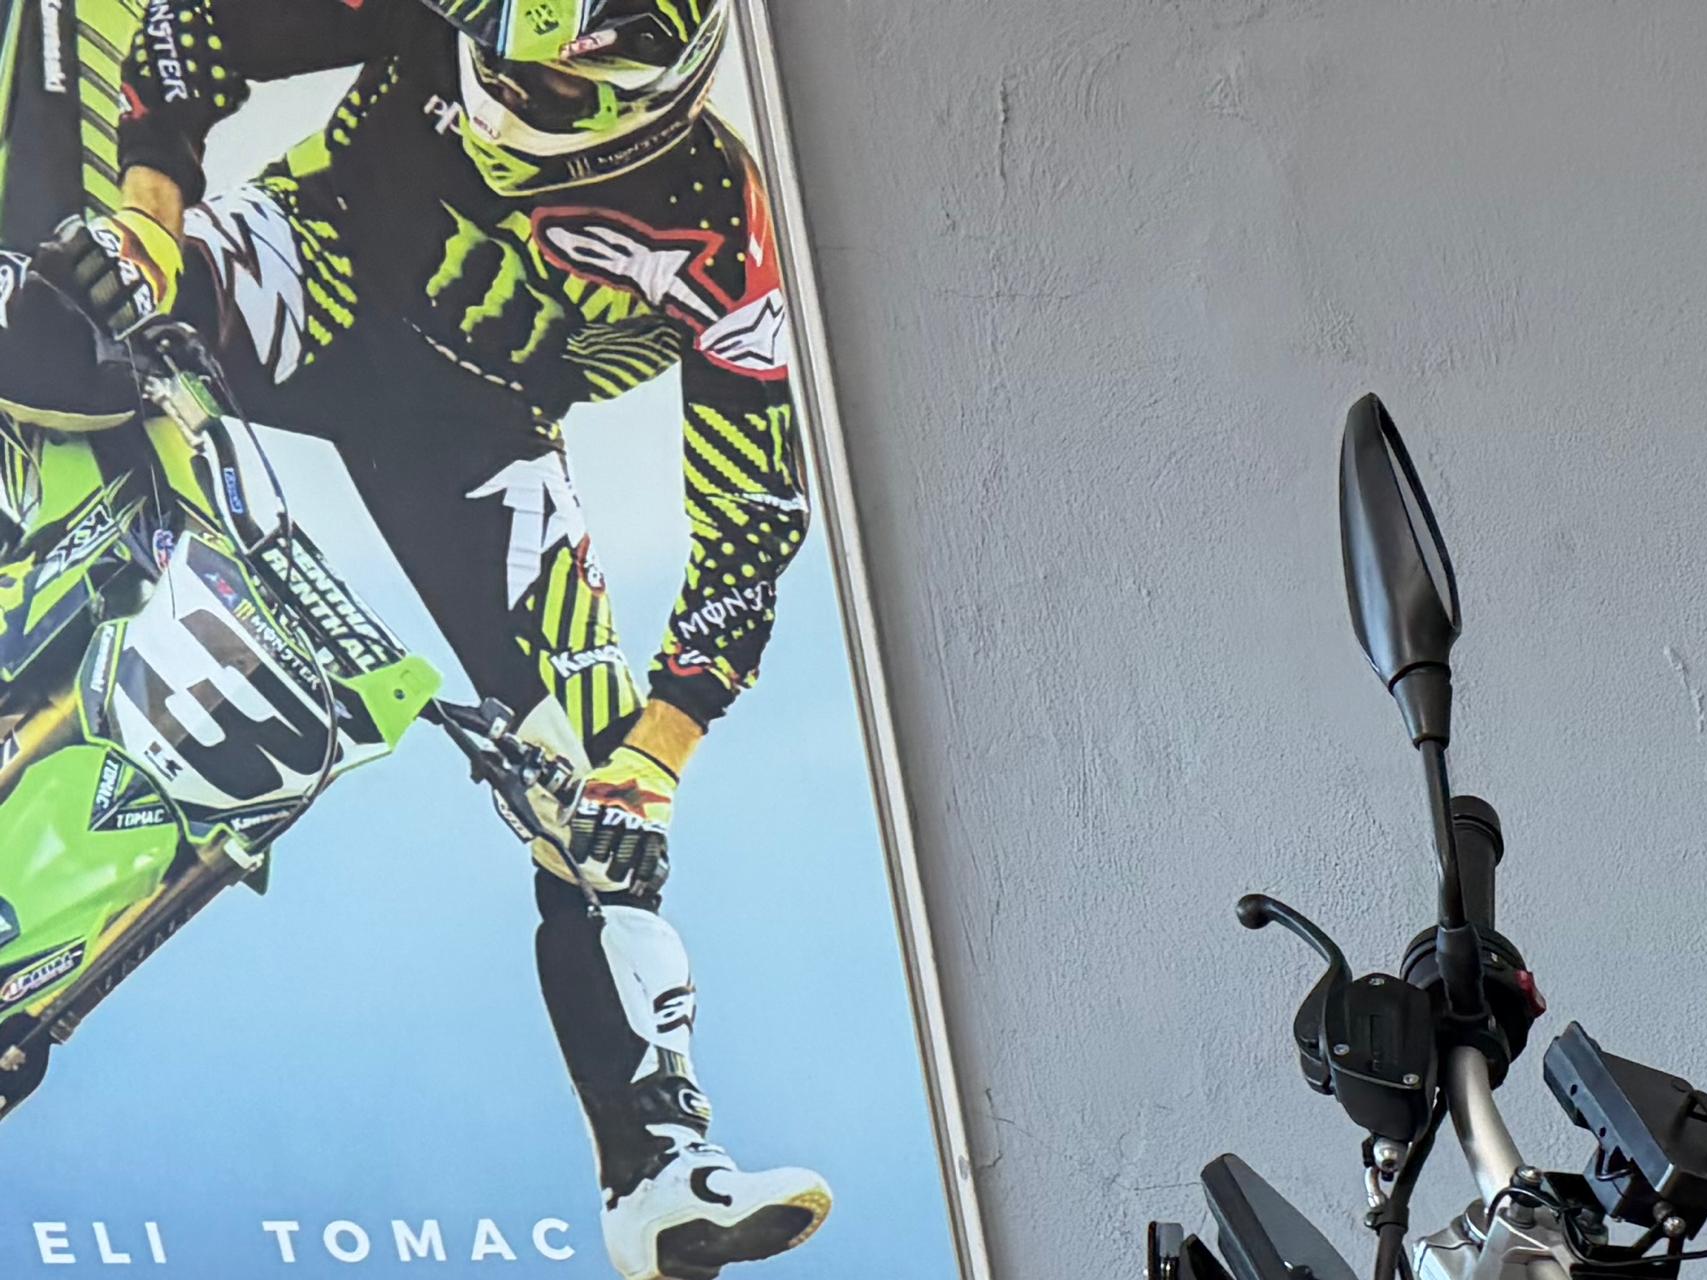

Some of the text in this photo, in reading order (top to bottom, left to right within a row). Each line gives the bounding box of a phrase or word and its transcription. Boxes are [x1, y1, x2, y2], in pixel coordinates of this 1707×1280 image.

[116, 809, 164, 829] TOMAC
[33, 1217, 577, 1264] ELI TOMAC
